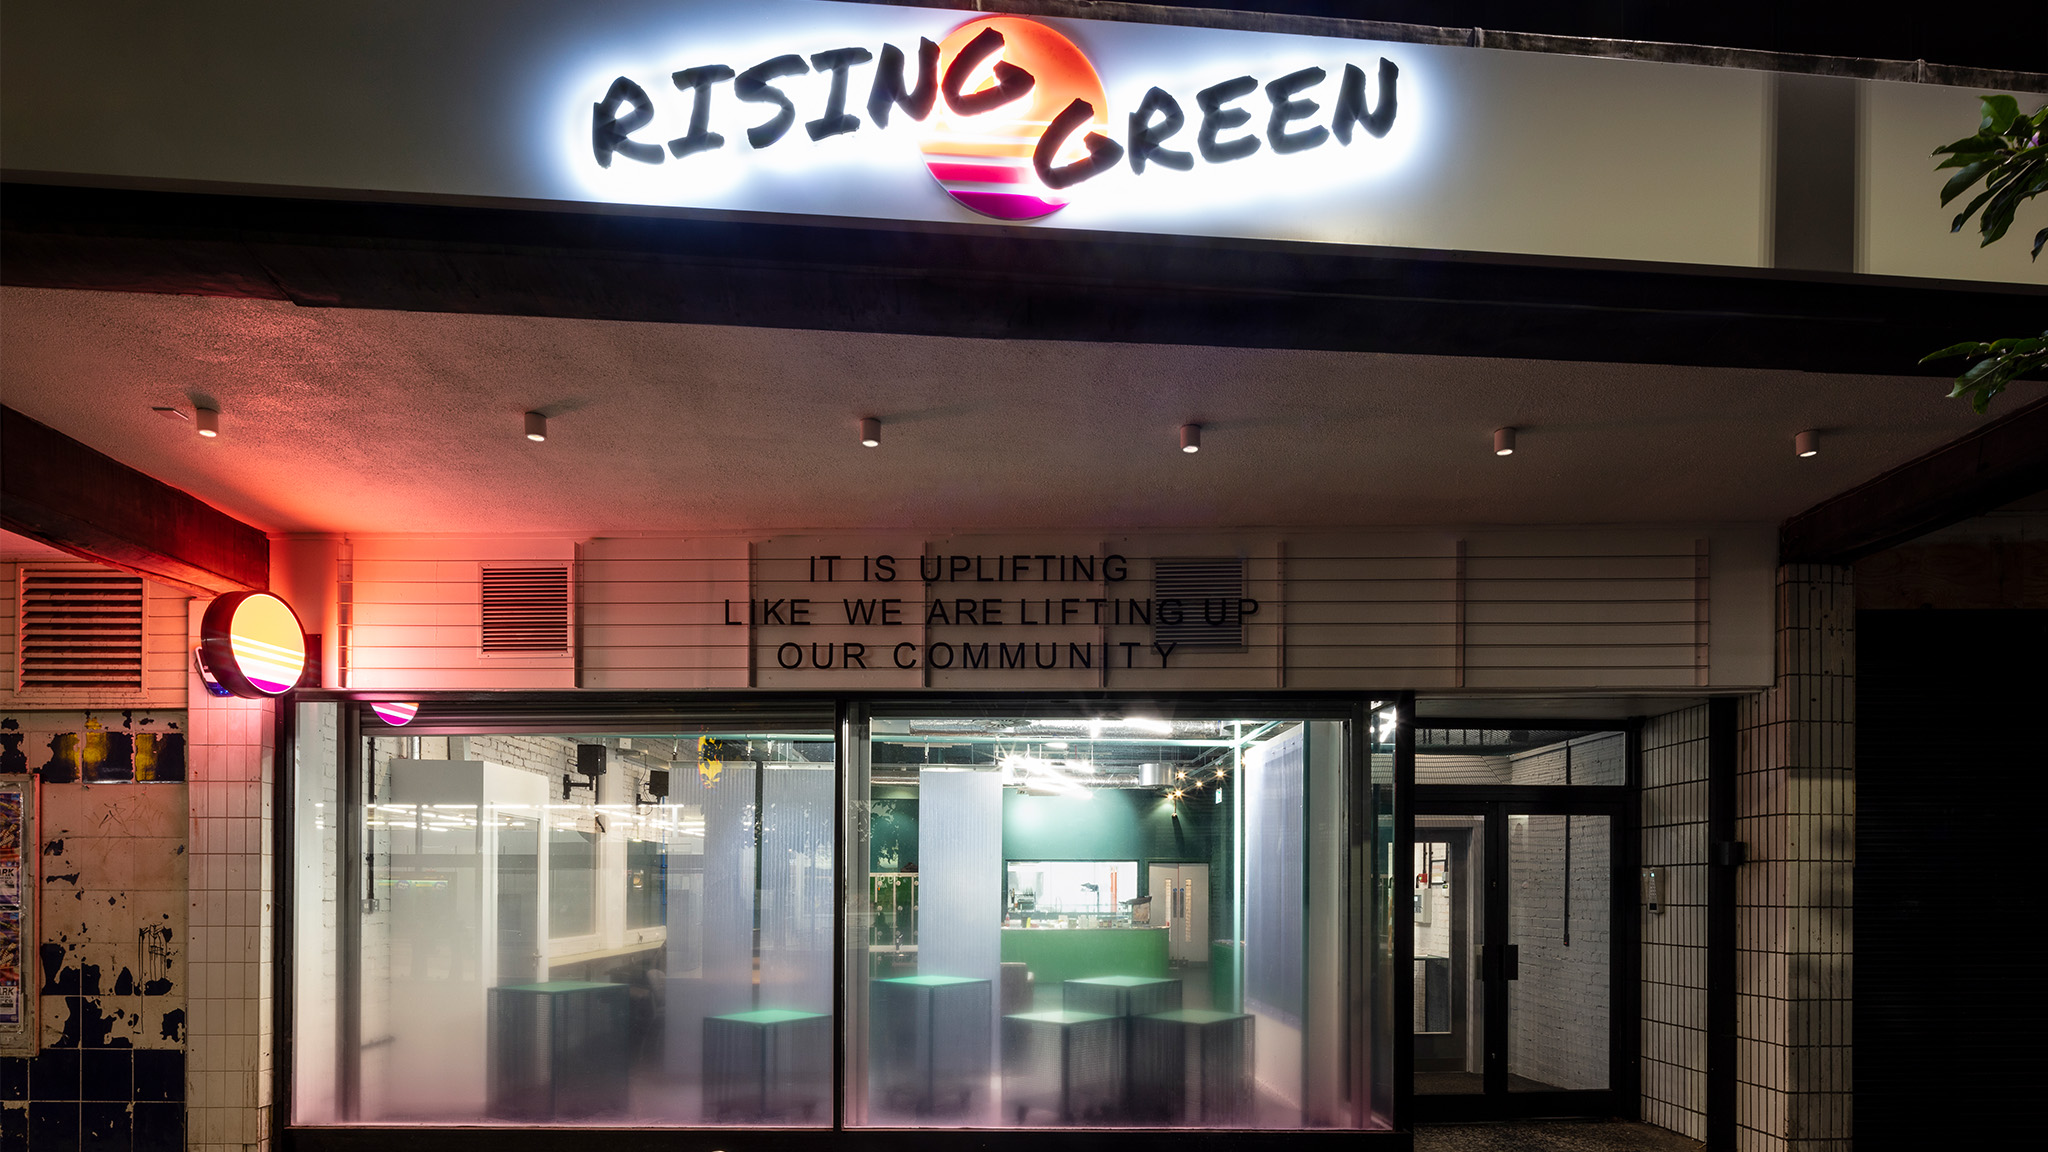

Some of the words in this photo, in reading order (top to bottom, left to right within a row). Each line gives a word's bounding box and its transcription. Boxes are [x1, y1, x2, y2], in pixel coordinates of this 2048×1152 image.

[593, 27, 1034, 169] RISING
[1033, 56, 1399, 190] GREEN
[810, 556, 841, 582] IT
[864, 555, 896, 582] IS
[920, 554, 1128, 583] UPLIFTING
[725, 598, 811, 626] LIKE
[844, 598, 903, 625] WE
[927, 598, 1001, 625] ARE
[1021, 598, 1185, 626] LIFTING
[1204, 599, 1259, 626] UP
[777, 642, 867, 670] OUR
[894, 641, 1177, 669] COMMUNITY
